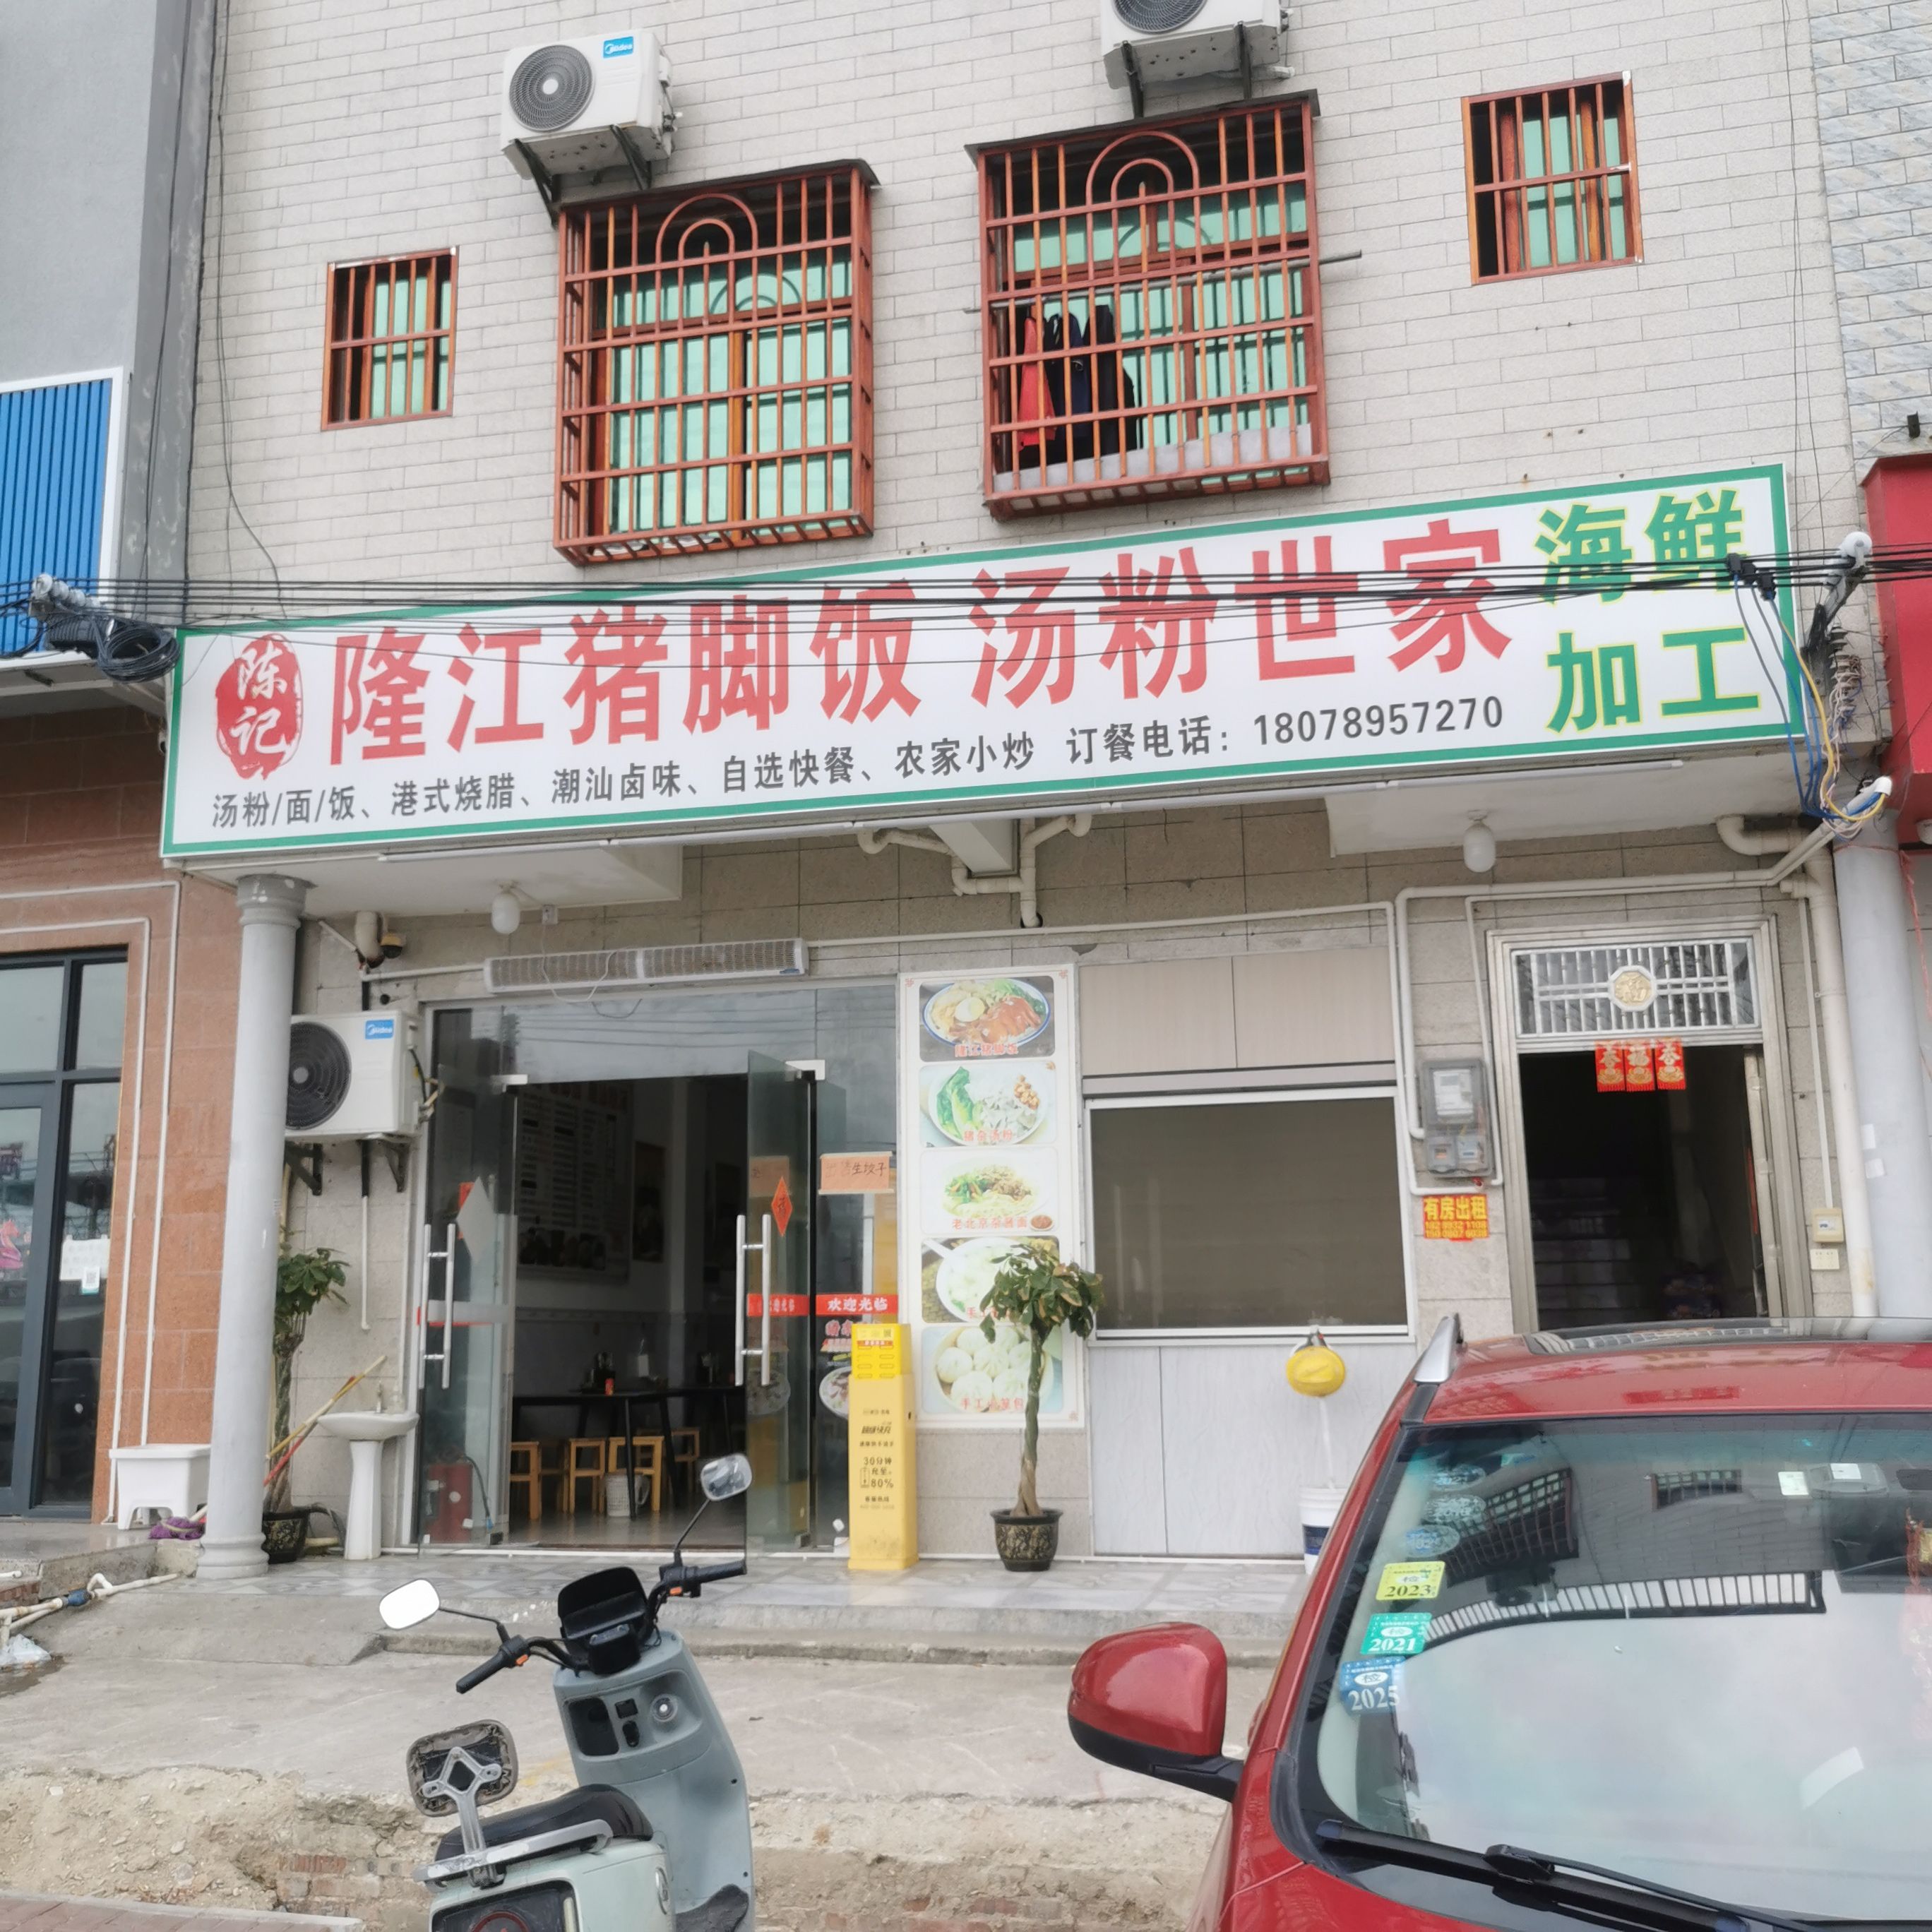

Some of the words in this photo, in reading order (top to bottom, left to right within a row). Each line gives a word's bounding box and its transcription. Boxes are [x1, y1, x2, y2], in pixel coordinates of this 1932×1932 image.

[1533, 487, 1747, 606] 海鲜
[330, 578, 921, 766] 隆江猪脚饭
[970, 518, 1513, 710] 汤粉世家
[1546, 626, 1761, 734] 加工
[229, 644, 287, 758] 陈记
[1253, 696, 1503, 746] 18078957270
[1424, 1195, 1487, 1220] 有房出租
[828, 1297, 888, 1311] 欢迎光临
[1384, 1584, 1431, 1597] 2023
[1368, 1638, 1417, 1652] 2021
[1348, 1685, 1400, 1711] 2025
